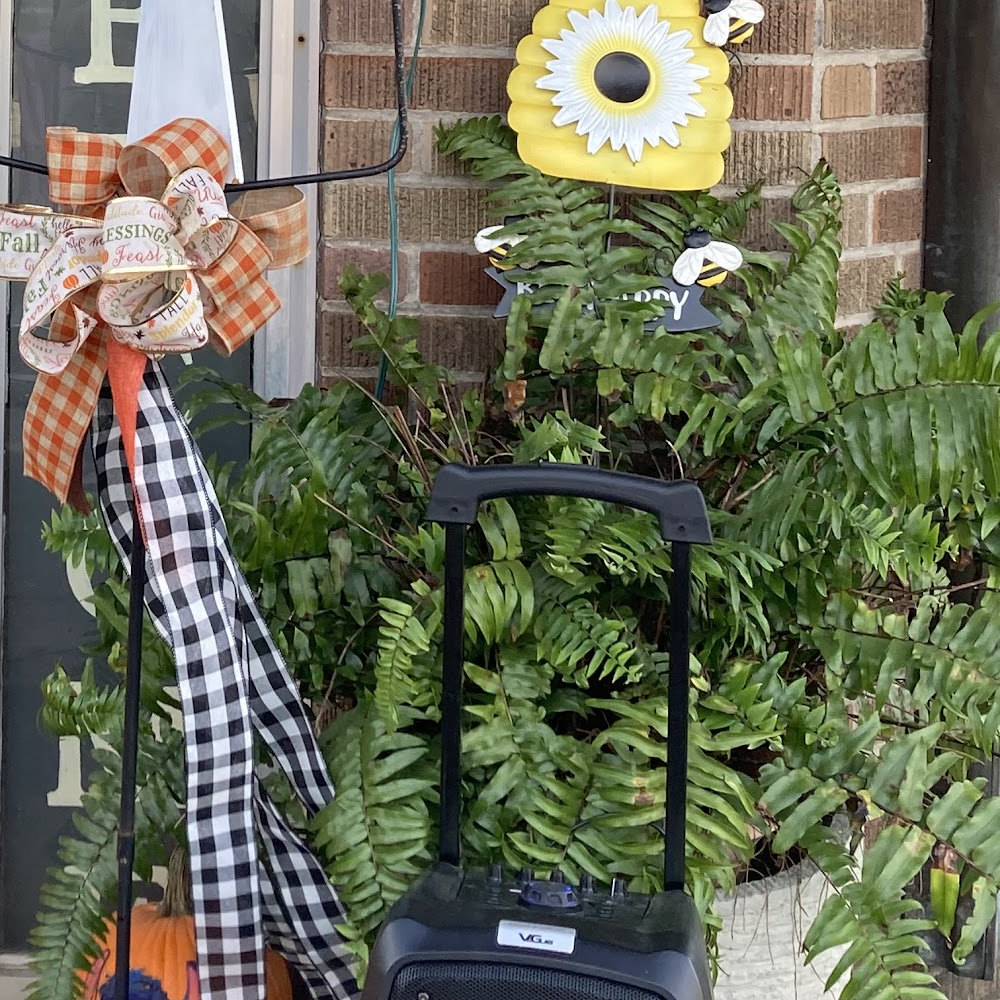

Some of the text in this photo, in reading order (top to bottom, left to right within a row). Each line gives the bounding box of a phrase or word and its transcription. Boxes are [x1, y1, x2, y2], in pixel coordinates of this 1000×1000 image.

[0, 230, 40, 253] Fall
[105, 224, 172, 245] ESSINGS
[112, 243, 164, 267] Feast
